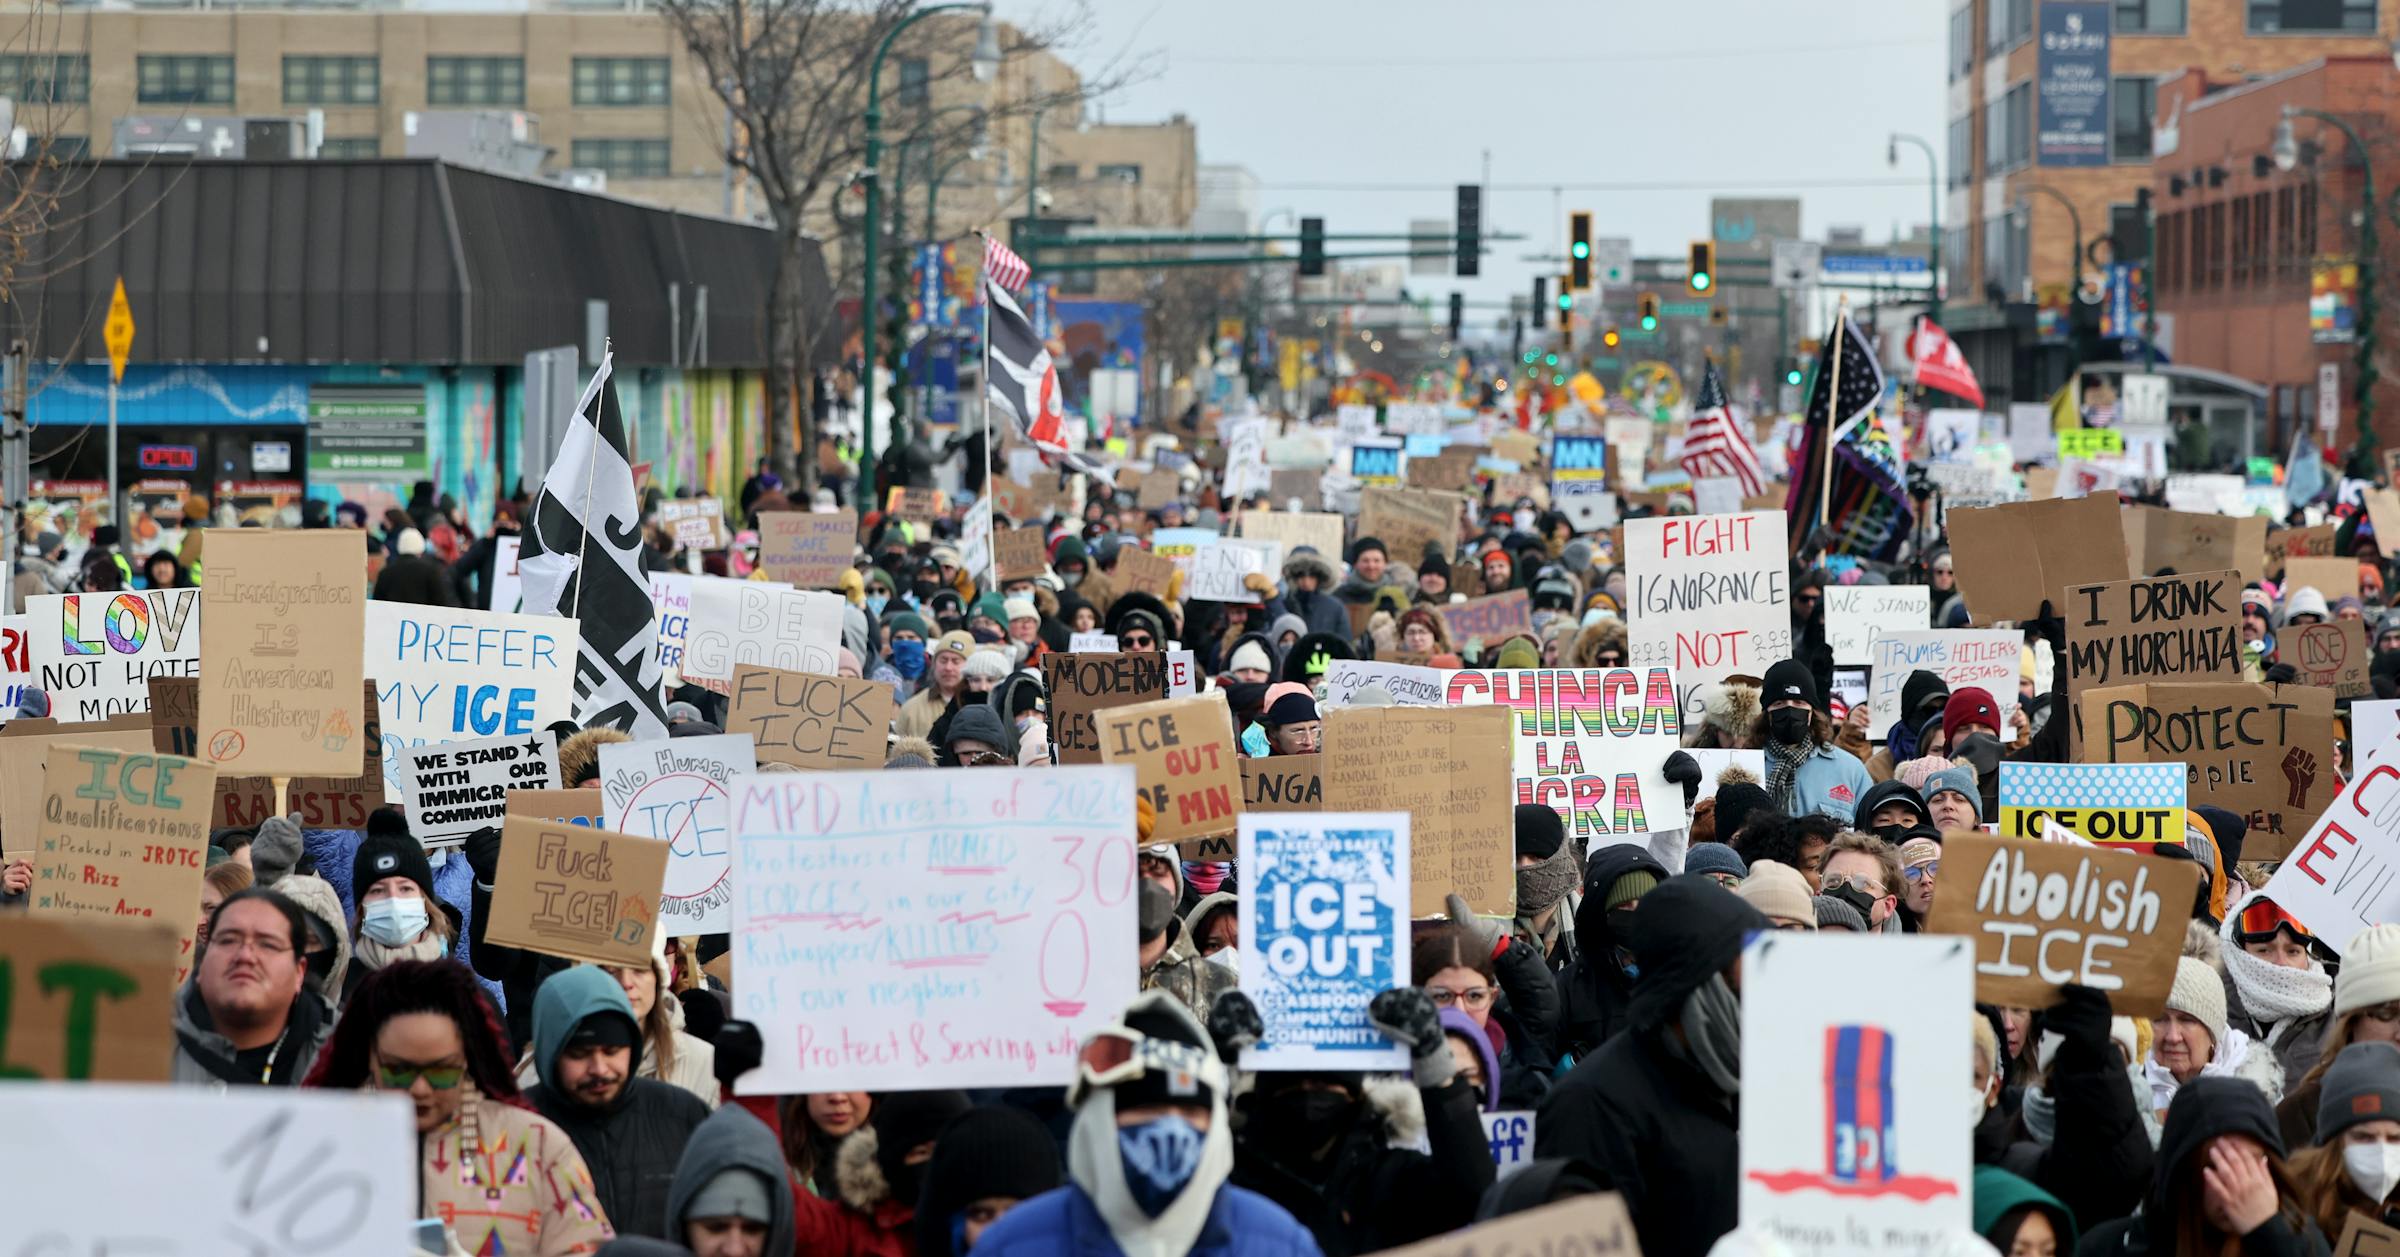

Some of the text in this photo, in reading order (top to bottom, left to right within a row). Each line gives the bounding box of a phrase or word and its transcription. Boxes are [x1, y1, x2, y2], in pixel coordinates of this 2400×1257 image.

[142, 449, 194, 467] OPEN
[1353, 449, 1399, 475] MN
[1555, 439, 1604, 468] MN
[2064, 434, 2116, 451] ICE
[775, 521, 805, 536] ICE
[791, 536, 829, 552] SAFE
[1662, 516, 1755, 558] FIGHT
[780, 568, 833, 584] UNSAFE
[1637, 571, 1785, 618] IGNORANCE
[63, 590, 199, 656] LOV
[738, 586, 807, 642] BE
[1828, 591, 1927, 614] WE STAND
[2079, 580, 2227, 627] I DRINK
[398, 619, 558, 668] PREFER
[692, 630, 835, 677] GOOD
[1676, 630, 1749, 670] NOT
[2071, 624, 2240, 683] MY HORCHATA
[2304, 632, 2341, 665] ICE
[42, 661, 103, 691] NOT
[223, 658, 335, 690] American
[80, 693, 152, 722] MAK
[231, 694, 320, 738] History
[376, 682, 439, 722] MY
[452, 685, 537, 735] ICE
[736, 671, 874, 726] FUCK
[1447, 667, 1679, 737] CHINGA
[750, 714, 865, 760] ICE
[1112, 714, 1180, 756] ICE
[2107, 701, 2299, 764] PROTECT
[413, 745, 519, 771] WE STAND
[416, 761, 548, 789] WITH OUR
[1166, 742, 1221, 777] OUT
[1537, 741, 1584, 776] LA
[76, 750, 188, 810] ICE
[605, 769, 648, 809] No
[46, 793, 203, 841] Qualifications
[421, 802, 507, 826] COMMUN
[738, 781, 841, 836] MPD
[858, 785, 969, 826] Arrests
[991, 778, 1023, 818] of
[1177, 785, 1233, 826] MN
[2015, 810, 2171, 840] ICE OUT
[639, 797, 728, 857] ICE
[120, 849, 132, 858] in
[143, 845, 200, 868] JROTC
[537, 832, 613, 882] Fuck
[881, 837, 911, 866] of
[928, 831, 1019, 867] ARMED
[1452, 856, 1494, 871] RENEE
[56, 863, 120, 887] No Rizz
[1051, 836, 1134, 907] 30
[1451, 873, 1496, 889] NICOLE
[1975, 847, 2161, 936] Abolish
[2296, 820, 2397, 930] EVIL
[114, 899, 153, 917] Aura
[532, 882, 618, 932] ICE!
[745, 876, 1036, 914] FORCES in our city
[1274, 881, 1378, 931] ICE
[1039, 908, 1091, 1001] 0
[1267, 935, 1384, 977] OUT
[1975, 920, 2129, 991] ICE
[746, 973, 983, 1016] of our neighbors
[1262, 993, 1373, 1010] CLASSROO
[1263, 1028, 1384, 1045] COMMUNITY
[1339, 1011, 1371, 1026] CIT
[796, 1022, 1080, 1073] Protect & Serving wh
